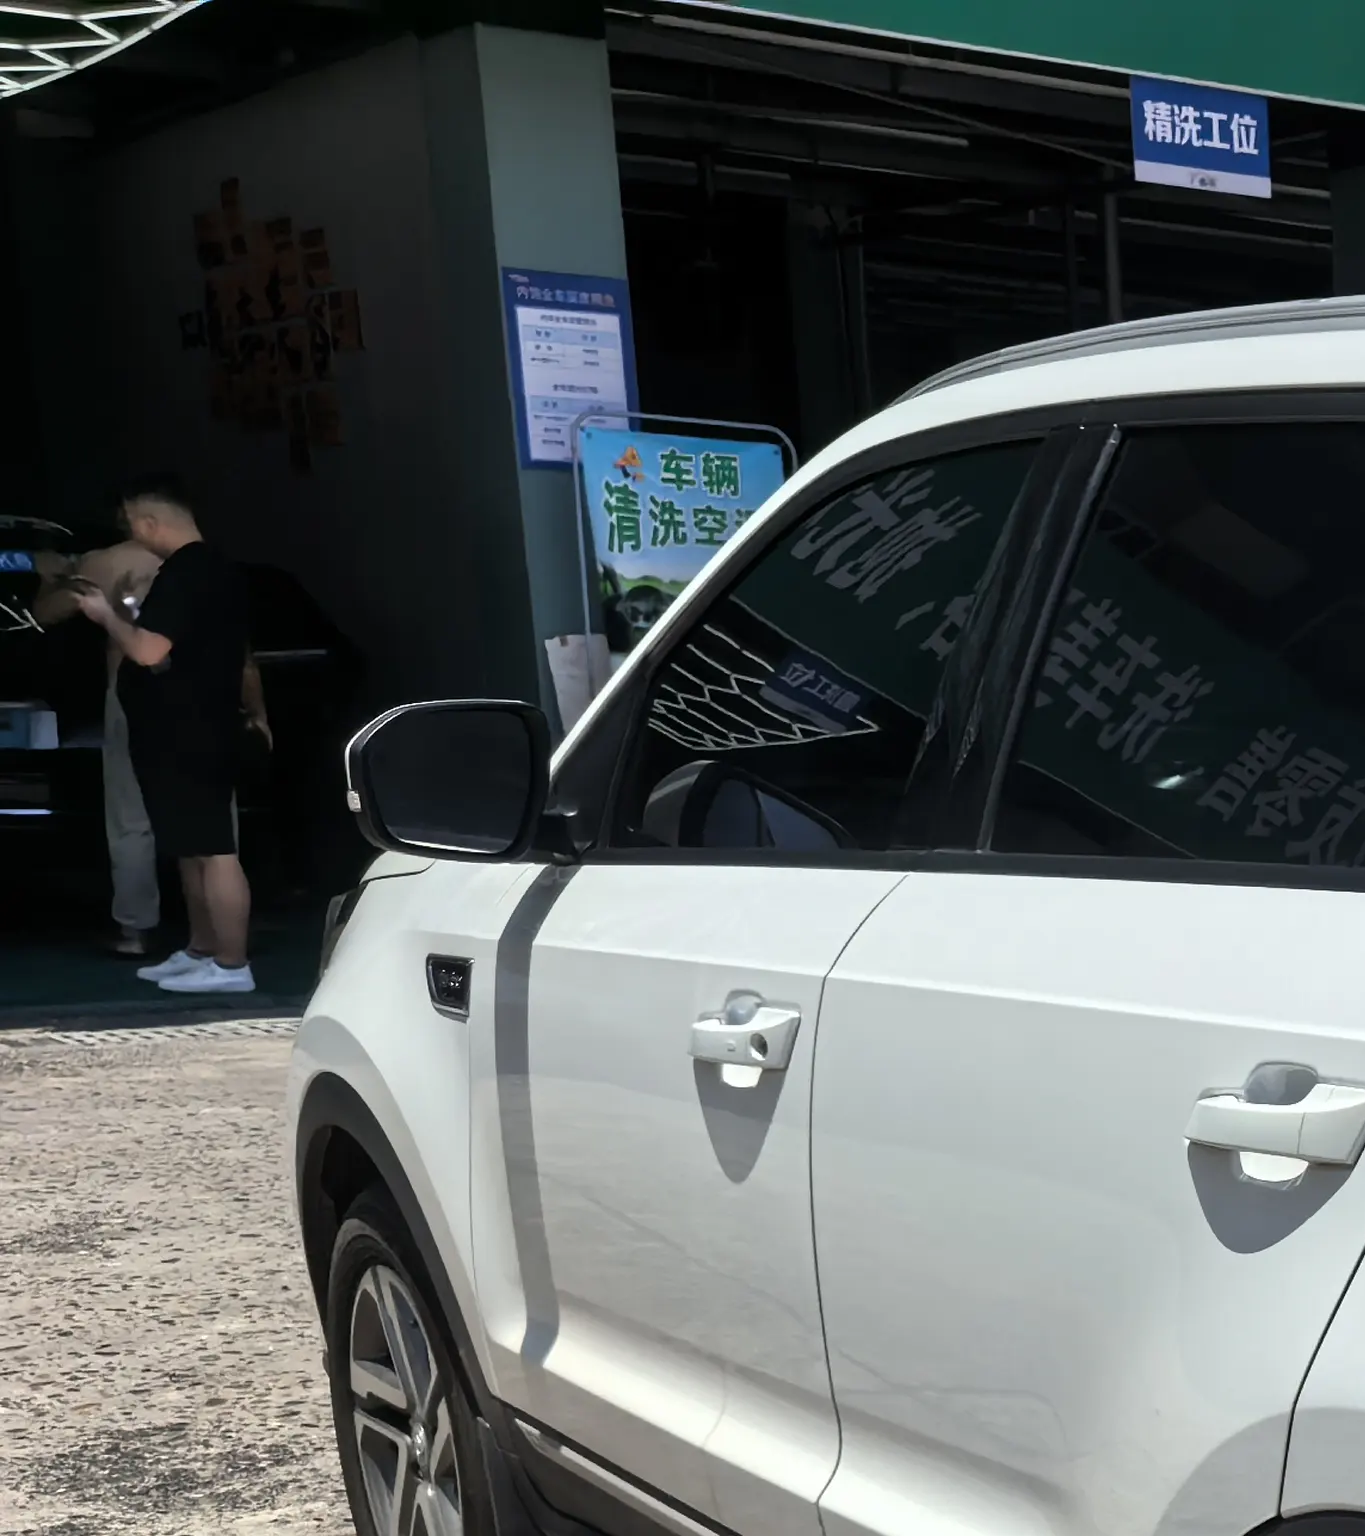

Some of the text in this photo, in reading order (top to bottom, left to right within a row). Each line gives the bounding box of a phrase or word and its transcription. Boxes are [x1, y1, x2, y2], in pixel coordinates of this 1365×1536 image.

[1142, 99, 1259, 155] 精洗工位
[659, 447, 742, 498] 车辆
[602, 478, 756, 554] 清洗空
